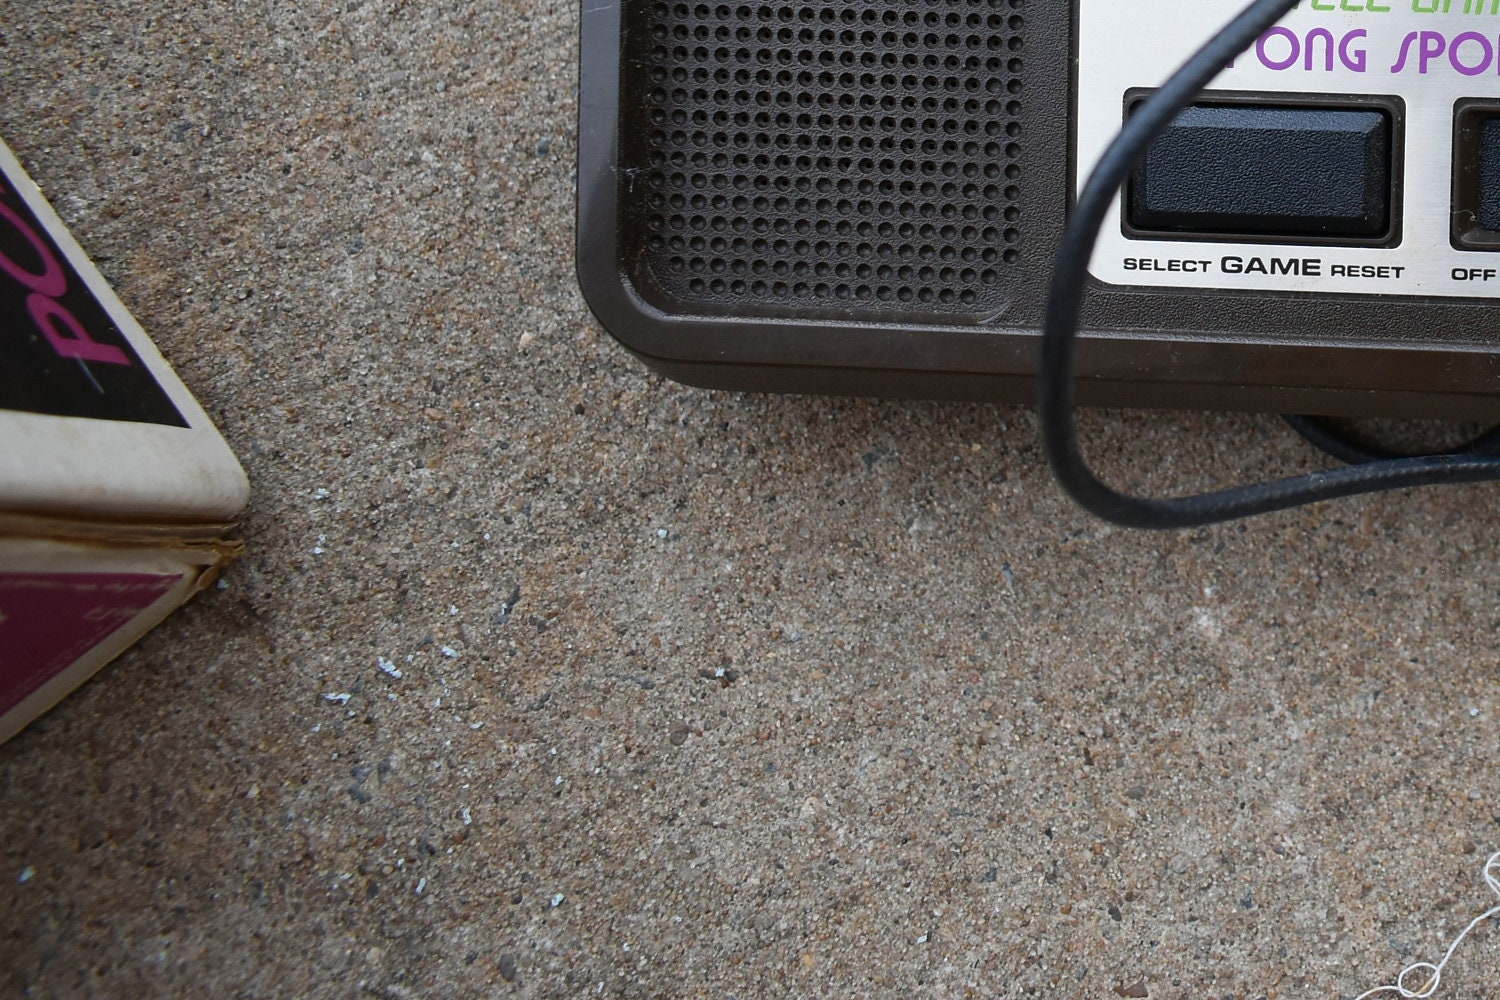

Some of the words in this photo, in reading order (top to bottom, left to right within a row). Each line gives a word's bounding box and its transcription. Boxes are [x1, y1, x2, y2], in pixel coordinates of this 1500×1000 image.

[1227, 26, 1368, 73] ONG
[1123, 257, 1212, 273] SELECT
[1220, 255, 1322, 276] GAME
[1330, 264, 1405, 279] RESET
[1451, 267, 1496, 281] OFF
